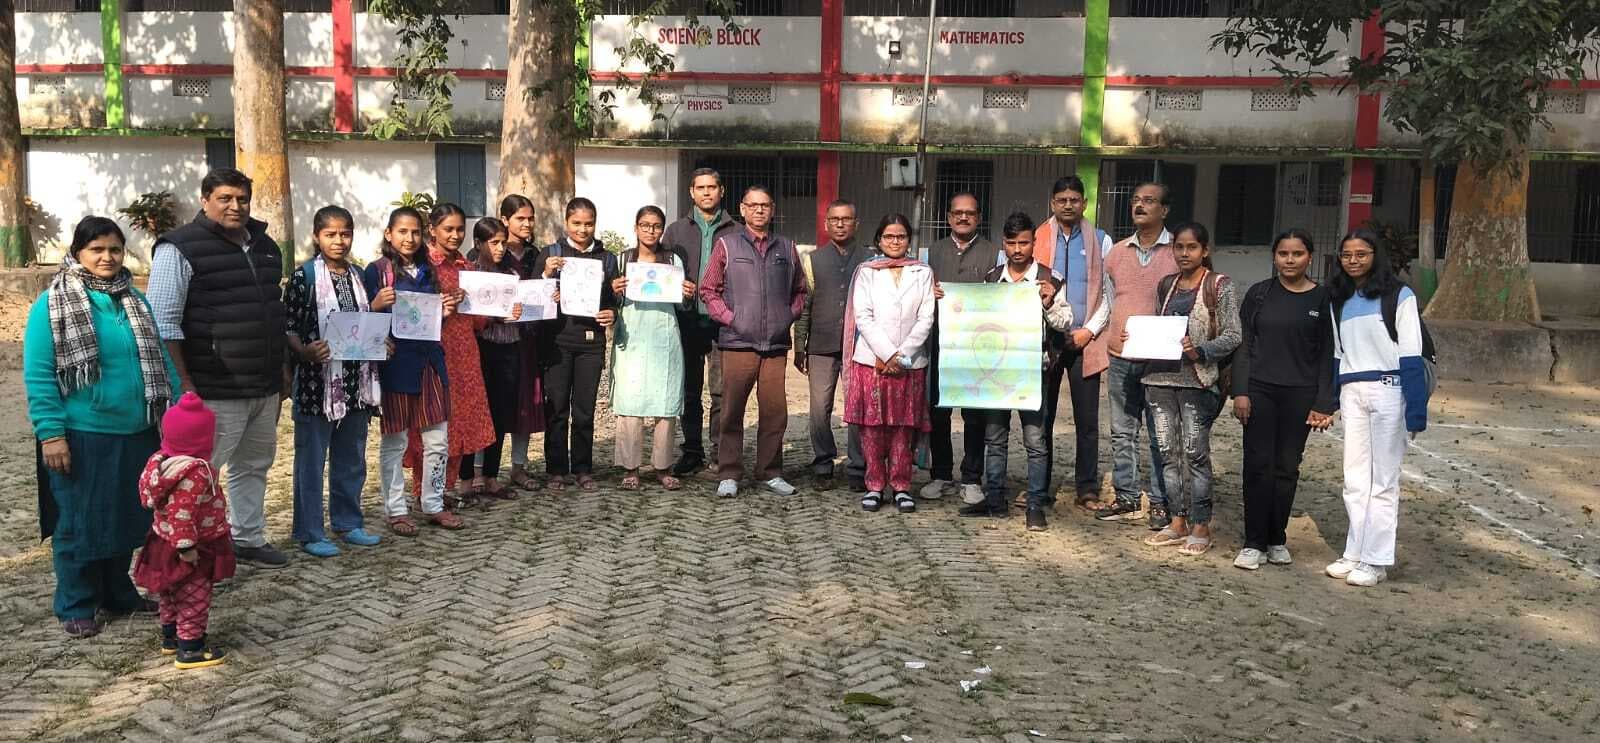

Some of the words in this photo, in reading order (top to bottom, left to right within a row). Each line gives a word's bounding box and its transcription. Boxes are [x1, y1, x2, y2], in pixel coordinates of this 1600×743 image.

[658, 27, 711, 45] SCIEN
[717, 28, 762, 46] BLOCK
[939, 31, 1025, 45] MATHEMATICS
[687, 99, 723, 111] PHYSICS
